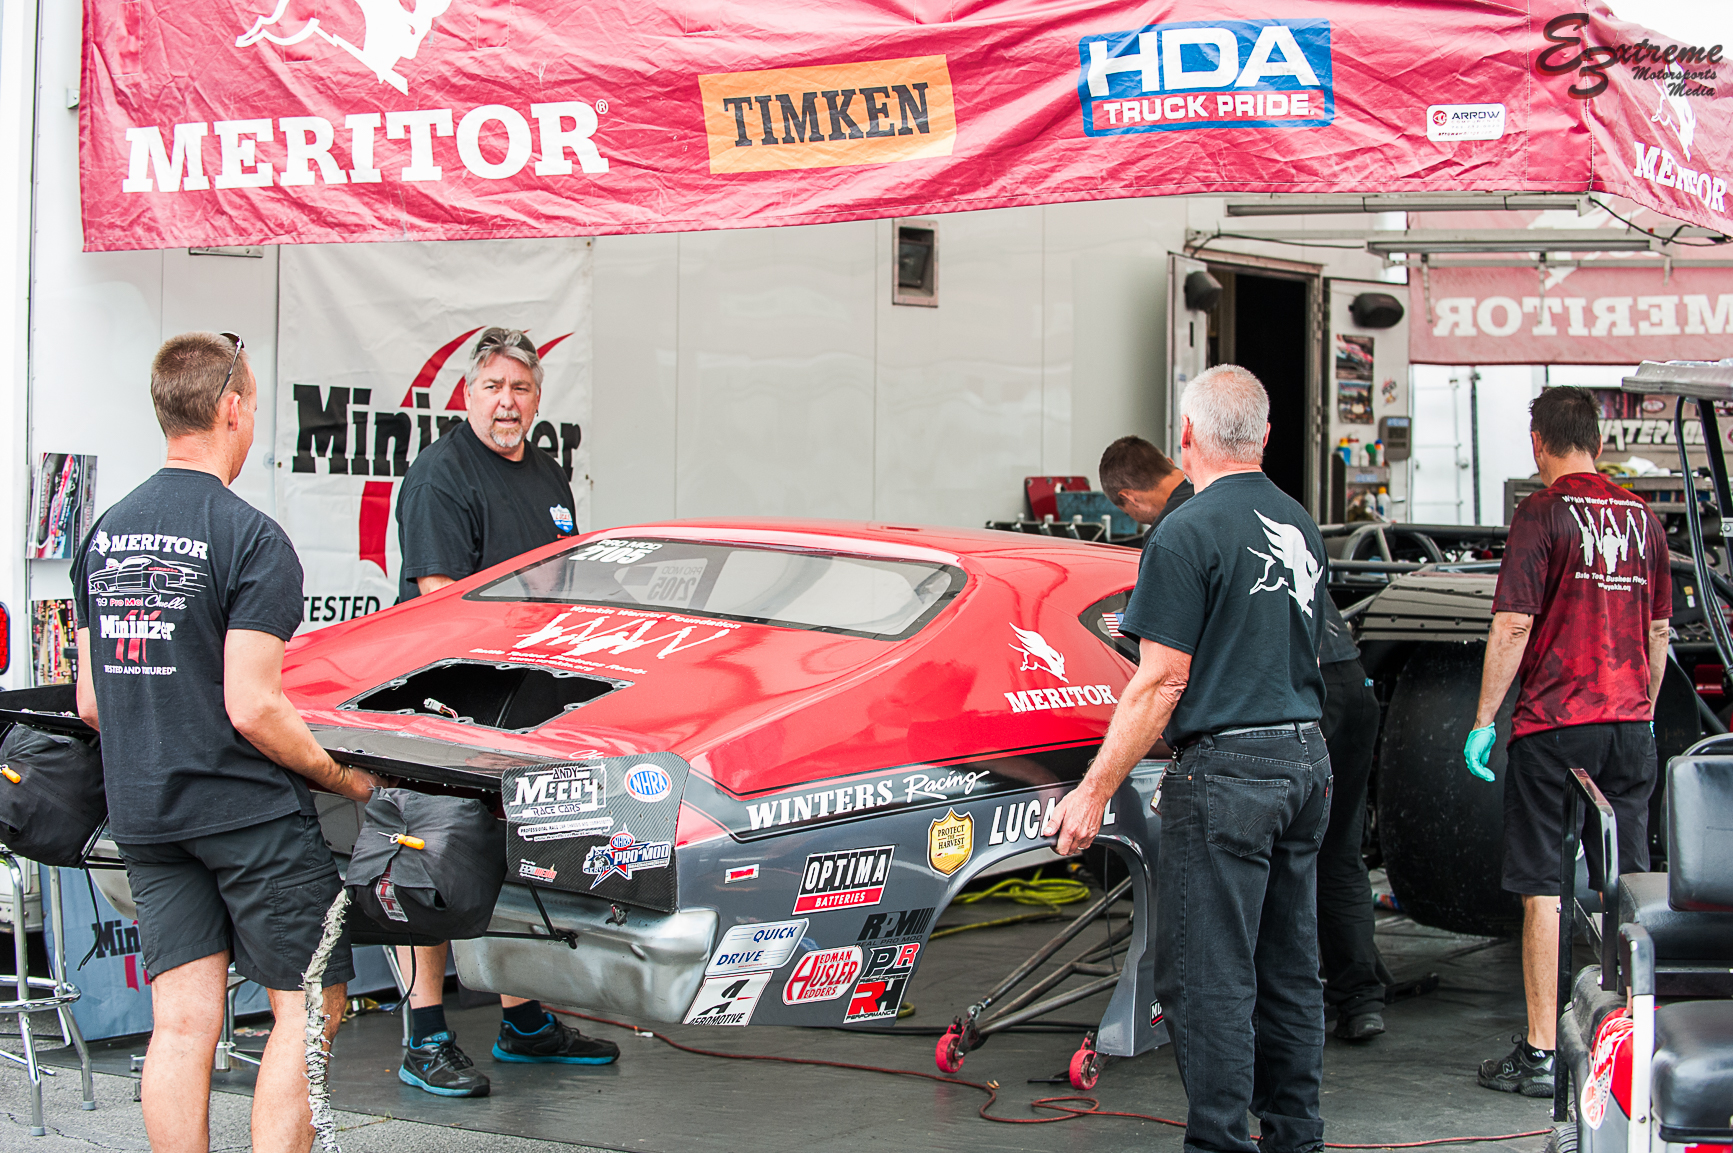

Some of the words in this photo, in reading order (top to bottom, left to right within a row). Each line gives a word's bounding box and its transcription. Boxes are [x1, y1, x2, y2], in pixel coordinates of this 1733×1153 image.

[1087, 25, 1321, 97] HDA
[723, 82, 931, 147] TIMKEN
[1103, 94, 1209, 125] TRUCK
[1451, 111, 1500, 120] ARROW
[110, 533, 208, 560] MERITOR
[597, 539, 627, 547] PRO
[626, 541, 663, 550] MOD
[569, 545, 653, 564] 2105
[109, 598, 124, 607] Pro
[617, 609, 666, 619] Warrior
[666, 614, 742, 630] Foundation
[123, 666, 141, 675] AND
[1003, 684, 1119, 713] MERITOR
[553, 767, 578, 780] ANDY
[629, 771, 668, 796] NHRA
[745, 780, 894, 831] WINTERS
[903, 770, 990, 803] Racing
[530, 806, 556, 817] RACE
[558, 803, 582, 814] CARS
[988, 797, 1057, 846] LUCA
[937, 825, 965, 838] PROTECT
[938, 837, 965, 850] HARVEST
[804, 853, 887, 894] OPTIMA
[814, 891, 866, 908] BATTERIES
[753, 926, 798, 943] QUICK
[880, 937, 899, 945] PRO
[901, 934, 923, 942] MOD
[716, 950, 765, 966] DRIVE
[846, 1009, 896, 1021] PERFORMANCE
